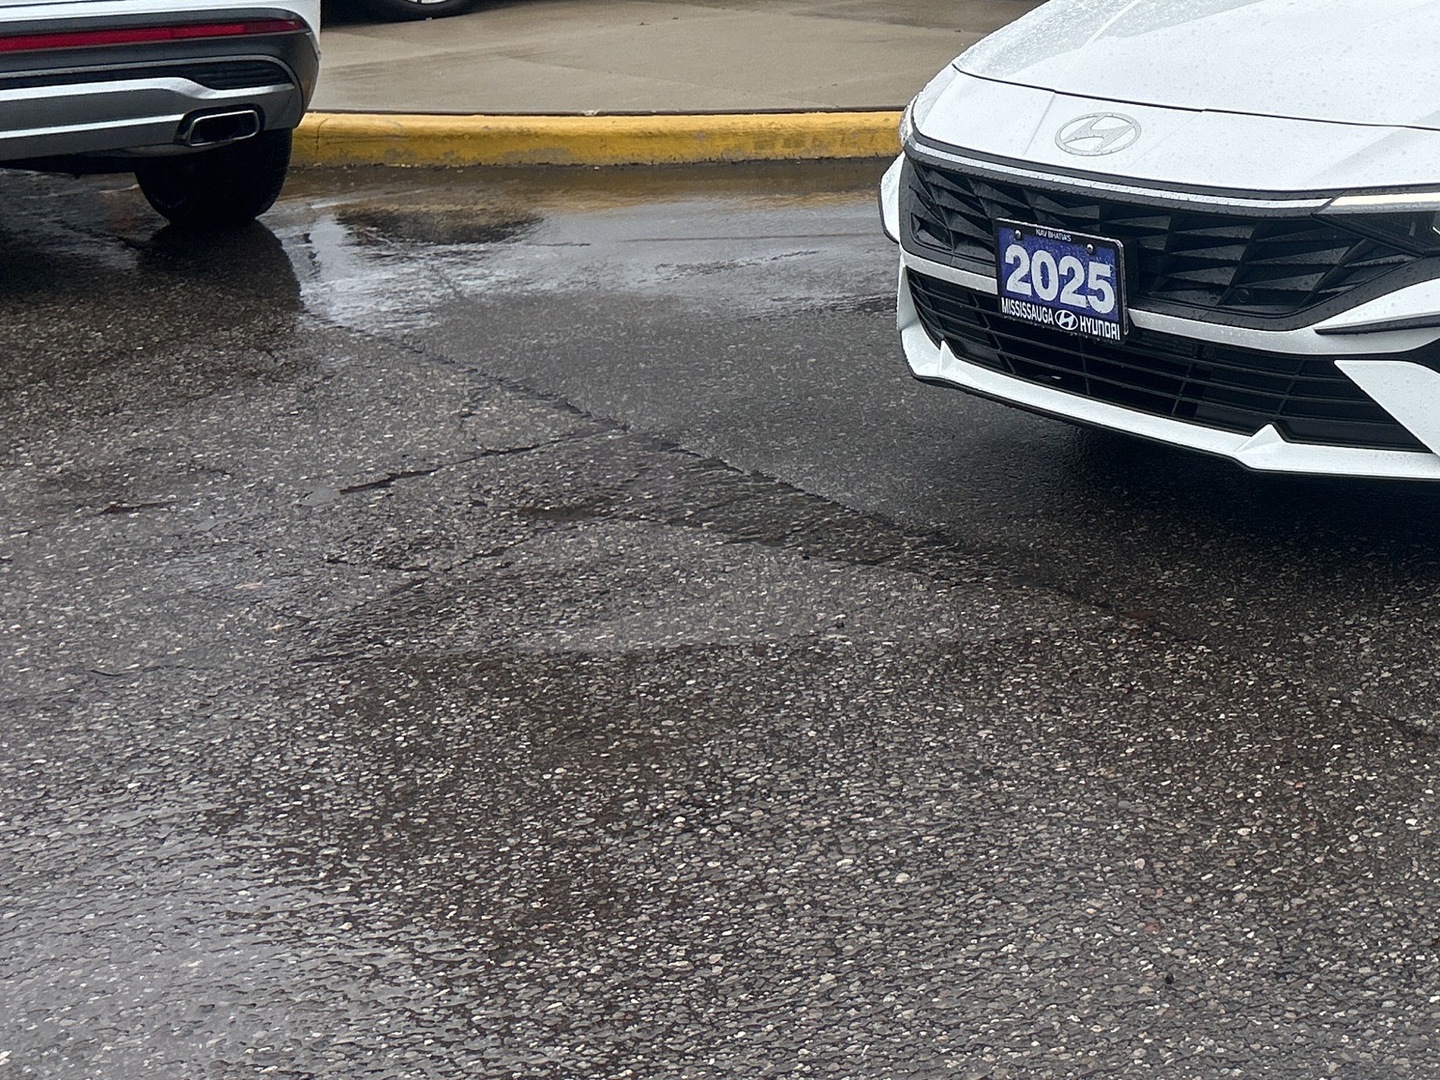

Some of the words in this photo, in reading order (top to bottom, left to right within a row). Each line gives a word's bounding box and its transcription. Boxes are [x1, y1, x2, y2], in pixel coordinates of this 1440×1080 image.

[1005, 244, 1115, 314] 2025
[1001, 297, 1055, 325] MISSISSAUGA
[1080, 315, 1121, 341] HYUNDAI
